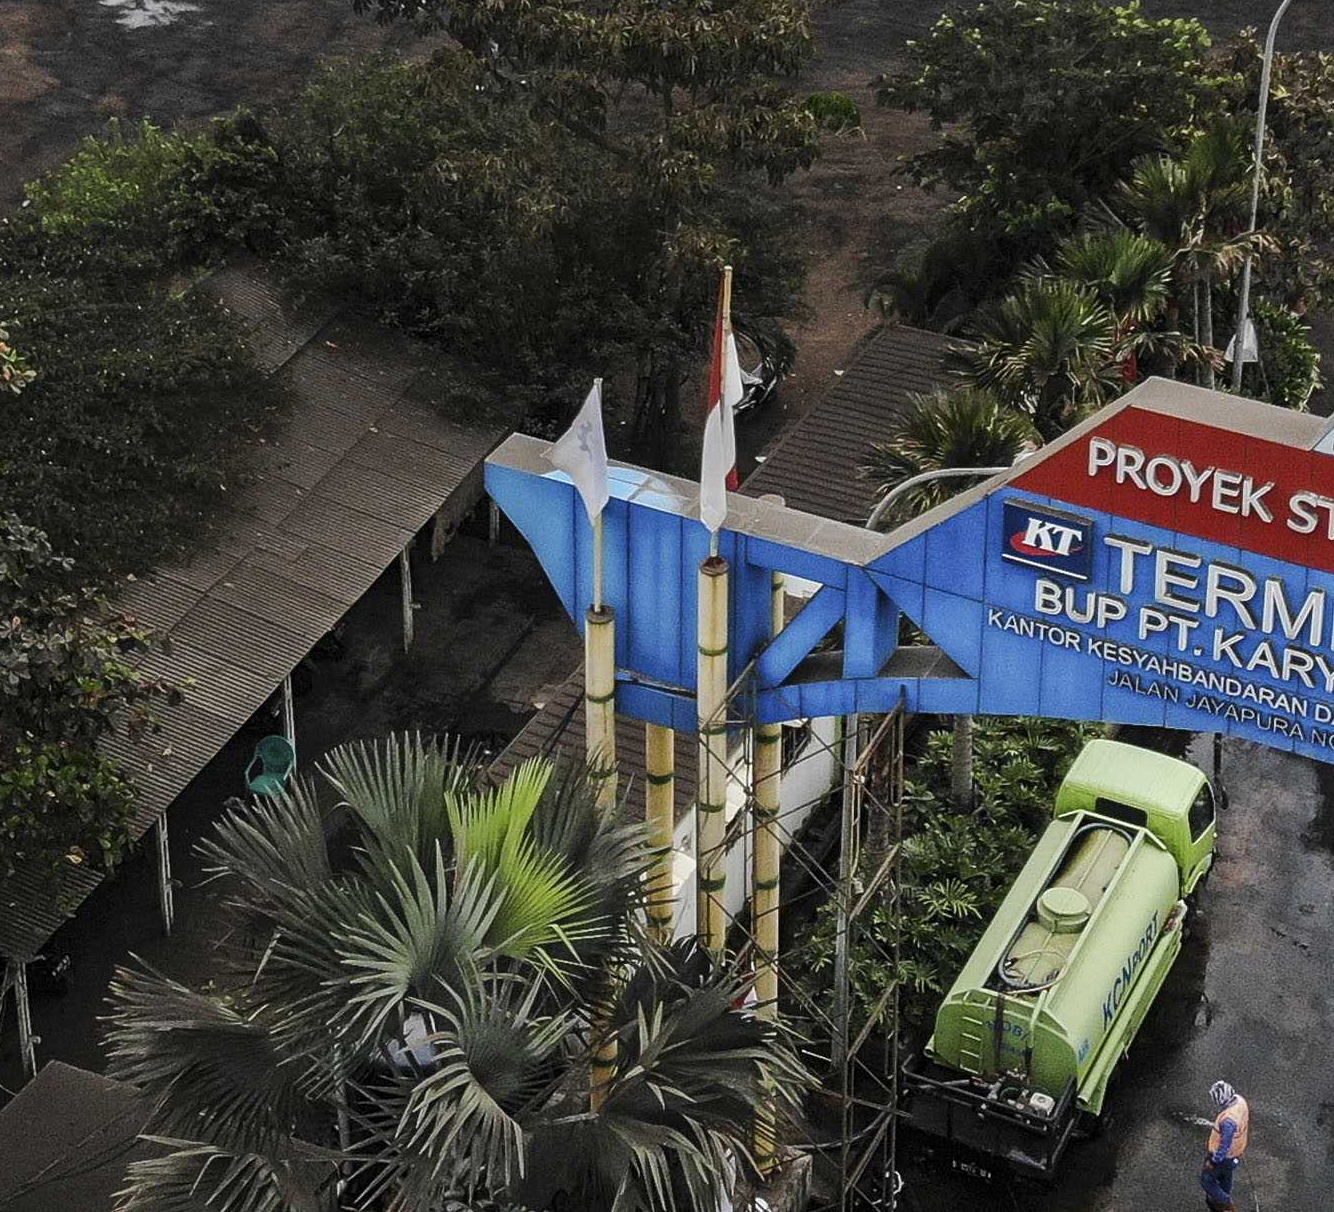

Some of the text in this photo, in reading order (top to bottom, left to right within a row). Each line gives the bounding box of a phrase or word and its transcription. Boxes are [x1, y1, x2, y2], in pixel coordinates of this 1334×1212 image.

[1088, 436, 1275, 523] PROYEK
[1021, 517, 1083, 556] KT
[1035, 577, 1128, 630] BUP
[988, 608, 1083, 654] KANTOR
[1087, 638, 1308, 718] KESYAHBANDARAN
[1108, 670, 1179, 704] JALAN
[1185, 690, 1304, 741] JAYAPURA
